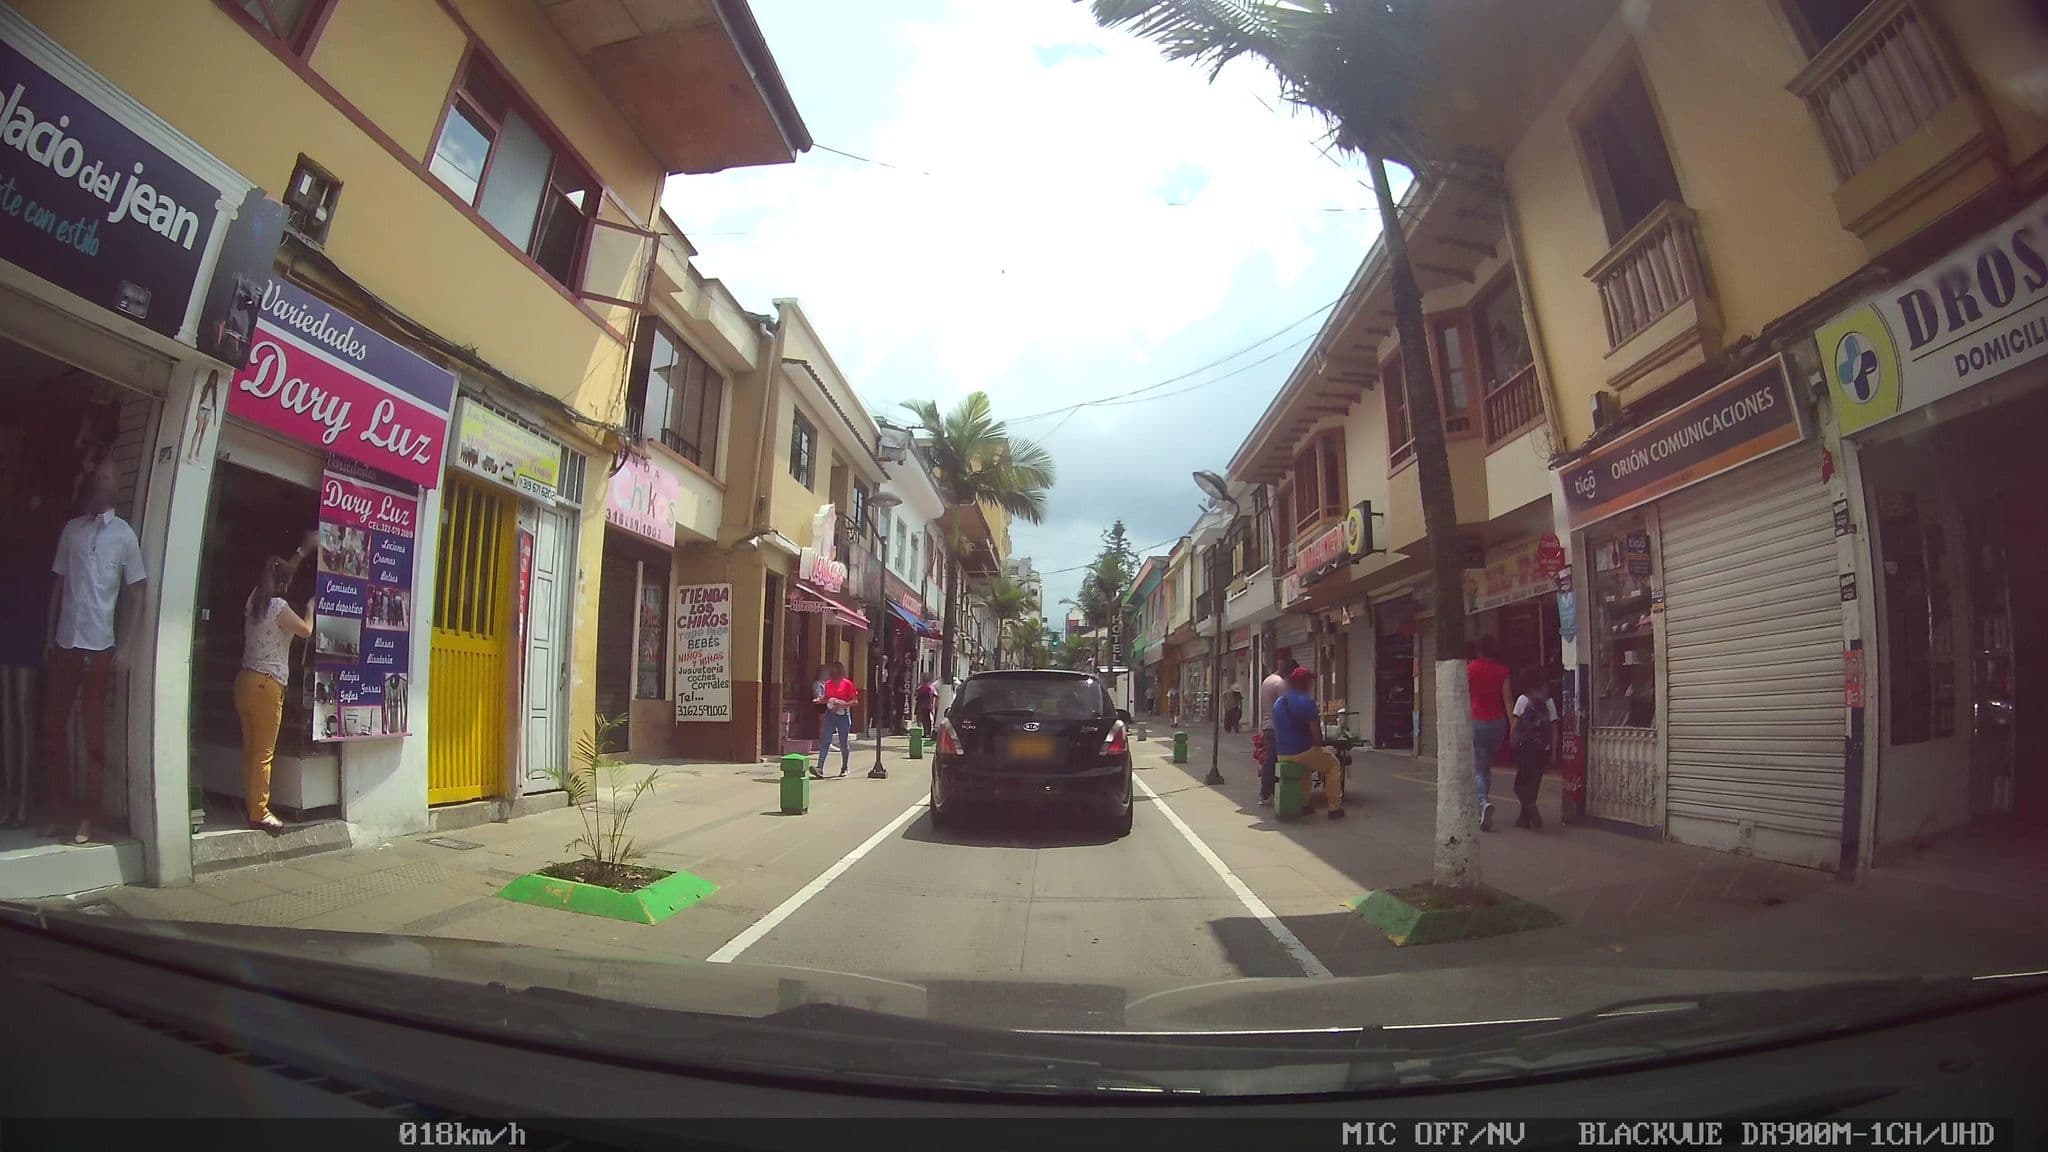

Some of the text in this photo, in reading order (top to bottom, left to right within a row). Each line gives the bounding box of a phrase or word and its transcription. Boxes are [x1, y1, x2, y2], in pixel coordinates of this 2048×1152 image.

[0, 83, 199, 250] lacio del jean
[0, 173, 100, 257] te con estilo
[1897, 222, 2048, 351] DROS
[261, 279, 367, 361] Variedades
[1954, 316, 2048, 377] DOMICILI
[240, 341, 352, 445] Dary
[360, 399, 432, 466] Luz
[1611, 449, 1649, 480] ORIÓN
[1650, 386, 1774, 462] COMUNICACIONES
[323, 479, 410, 525] Dary Luz
[327, 580, 357, 595] Camisetas
[680, 587, 729, 604] TIENDA
[318, 597, 363, 615] Ropa deportiva
[689, 603, 715, 615] LOS
[677, 613, 729, 630] CHIKOS
[374, 636, 394, 649] Blusas
[678, 629, 704, 642] TODO
[1111, 614, 1121, 663] HOTEL
[340, 670, 360, 684] Relojes
[340, 690, 359, 703] Gafas
[677, 705, 728, 717] 3162591002
